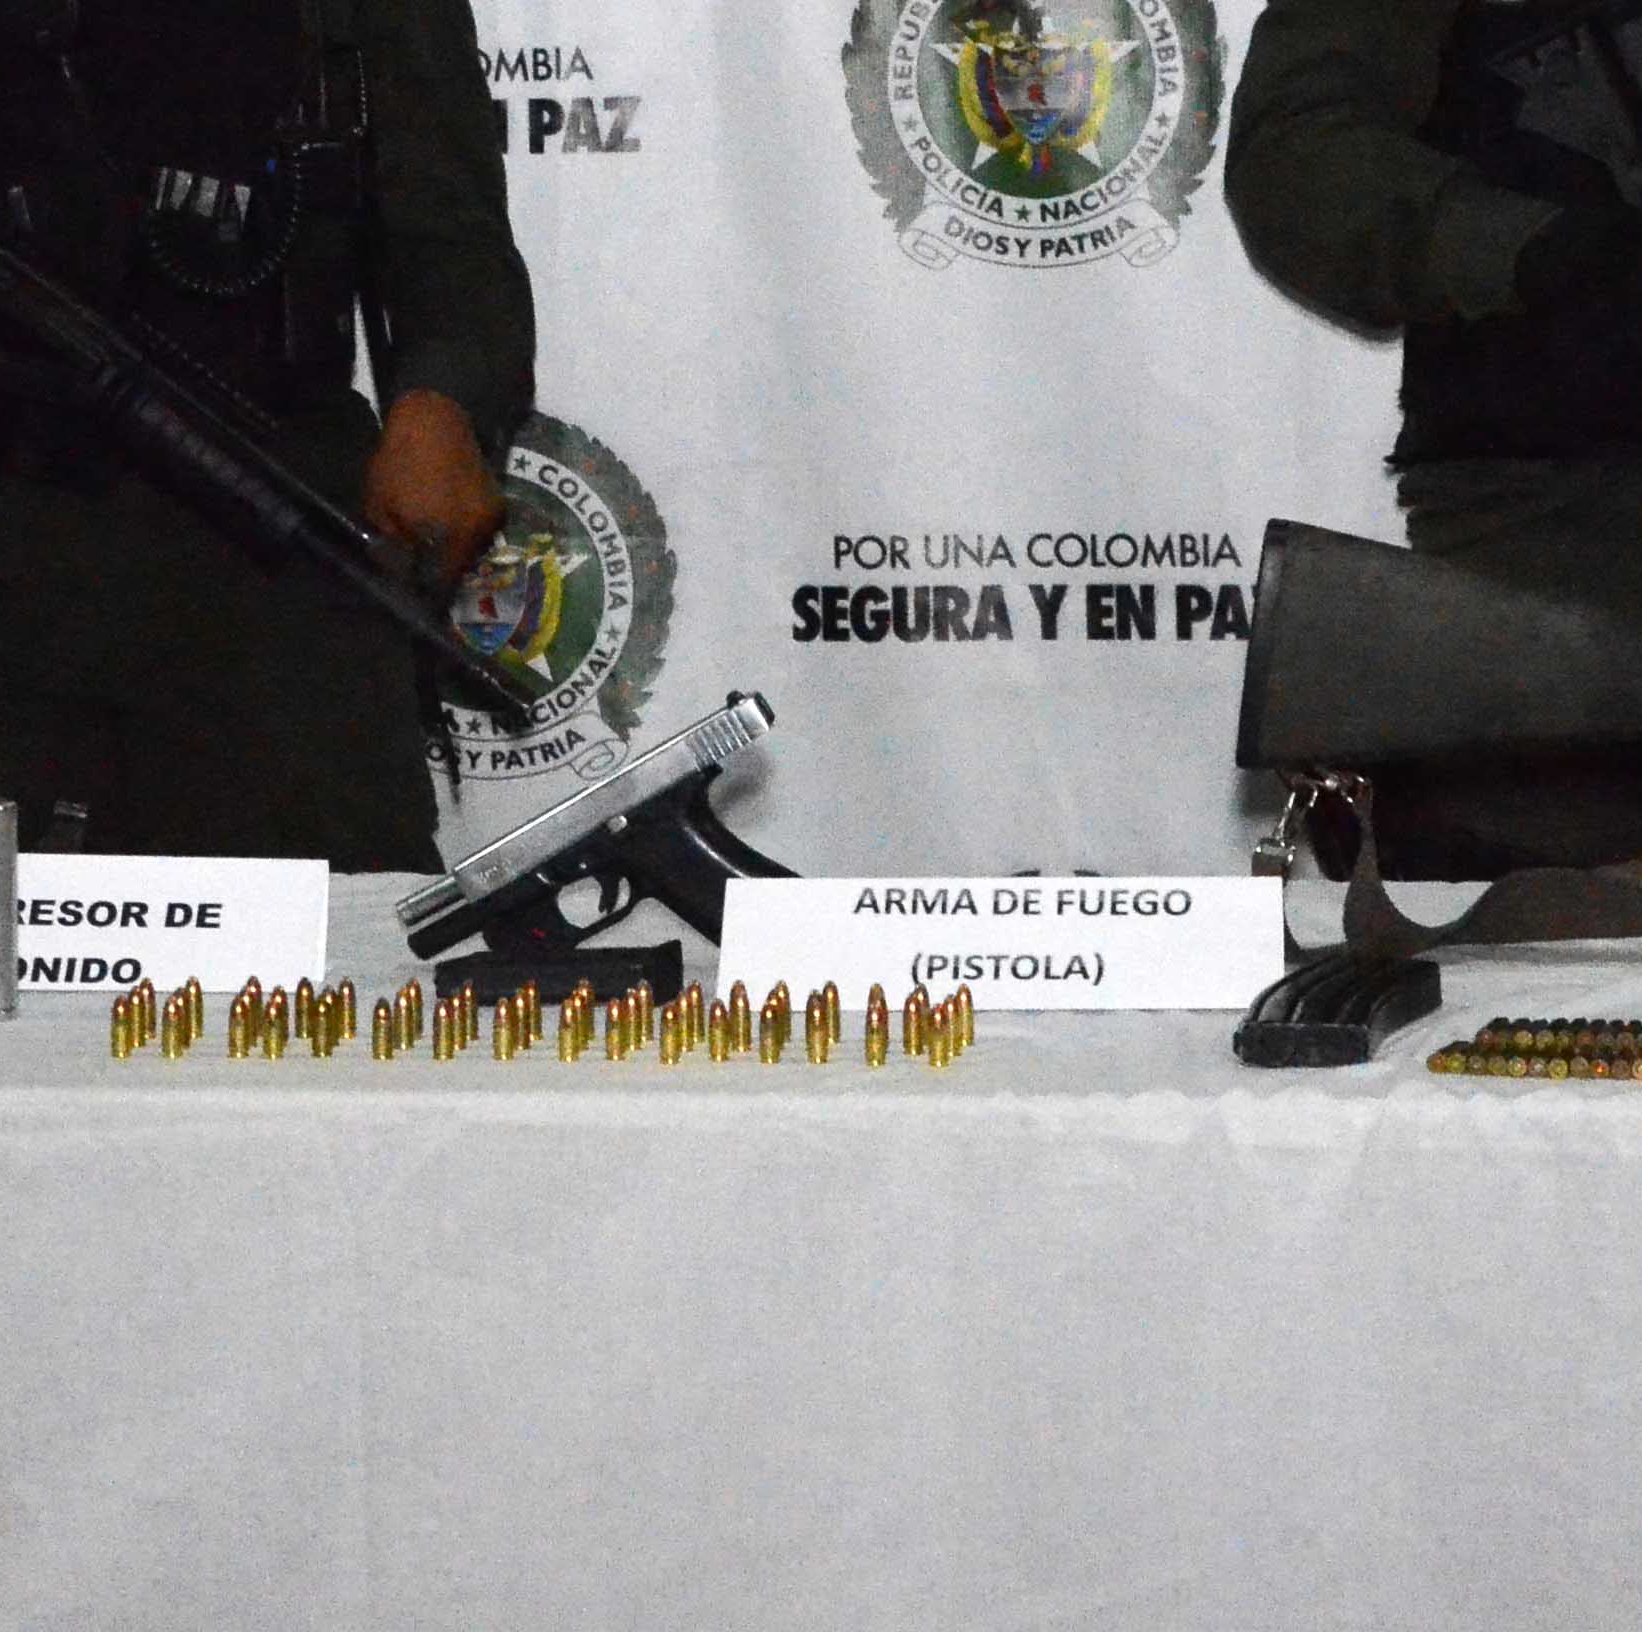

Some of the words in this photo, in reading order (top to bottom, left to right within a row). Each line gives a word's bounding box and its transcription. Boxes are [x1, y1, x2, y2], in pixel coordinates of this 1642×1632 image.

[528, 97, 641, 154] PAZ
[833, 534, 911, 571] POR
[924, 533, 1015, 569] UNA
[1026, 532, 1242, 569] COLOMBIA
[791, 583, 1014, 645] SEGURA
[1028, 583, 1069, 641] Y
[1085, 582, 1158, 642] EN
[1175, 582, 1252, 642] PA
[164, 902, 223, 929] DE
[853, 887, 979, 916] ARMA
[992, 888, 1043, 916] DE
[1056, 887, 1193, 916] FUEGO
[910, 952, 1105, 987] (PISTOLA)
